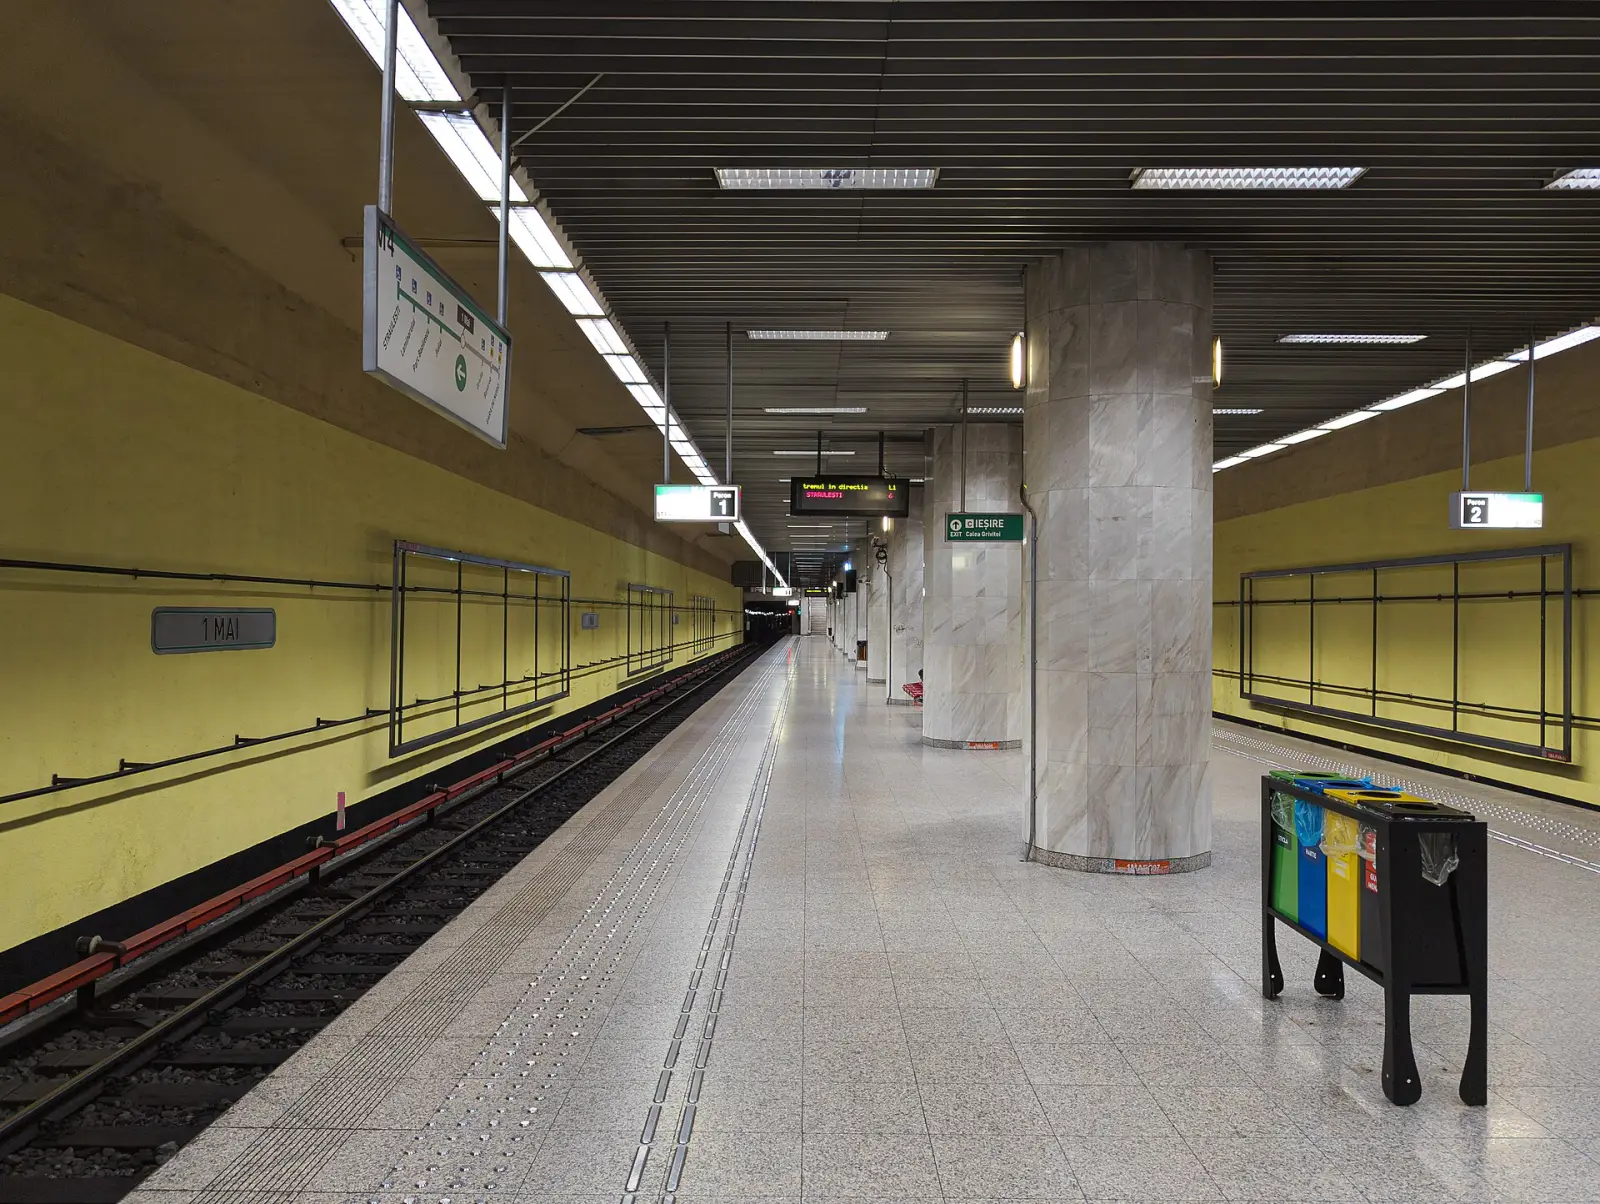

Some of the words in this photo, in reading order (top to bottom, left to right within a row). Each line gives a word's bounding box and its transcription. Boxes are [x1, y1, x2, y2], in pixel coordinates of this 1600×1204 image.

[838, 483, 868, 491] directia
[719, 499, 727, 515] 1
[1470, 506, 1482, 523] 2
[975, 519, 1004, 530] IEȘIRE
[202, 616, 208, 641] 1
[214, 616, 239, 641] MAI
